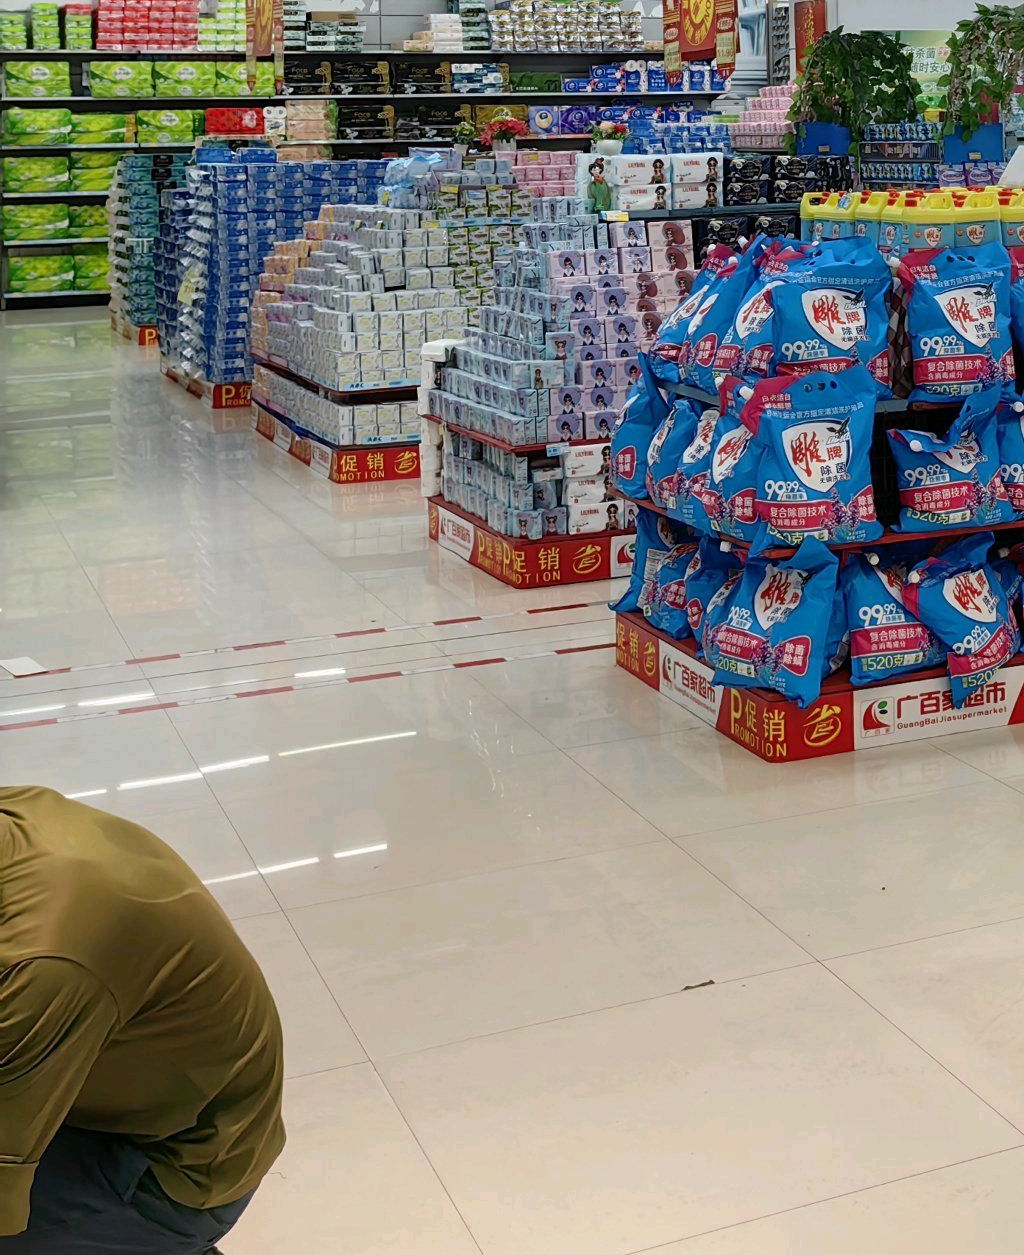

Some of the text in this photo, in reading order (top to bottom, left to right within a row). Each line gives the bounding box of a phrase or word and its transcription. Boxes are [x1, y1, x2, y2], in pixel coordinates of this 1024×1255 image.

[944, 295, 992, 333] 雕牌
[927, 359, 983, 371] 复合除菌技术
[340, 452, 384, 472] 促销
[791, 432, 842, 477] 雕牌
[913, 487, 969, 503] 复合除菌技术
[770, 505, 827, 517] 复合除菌技术
[869, 628, 924, 642] 复合除菌技术
[745, 697, 786, 743] 促销
